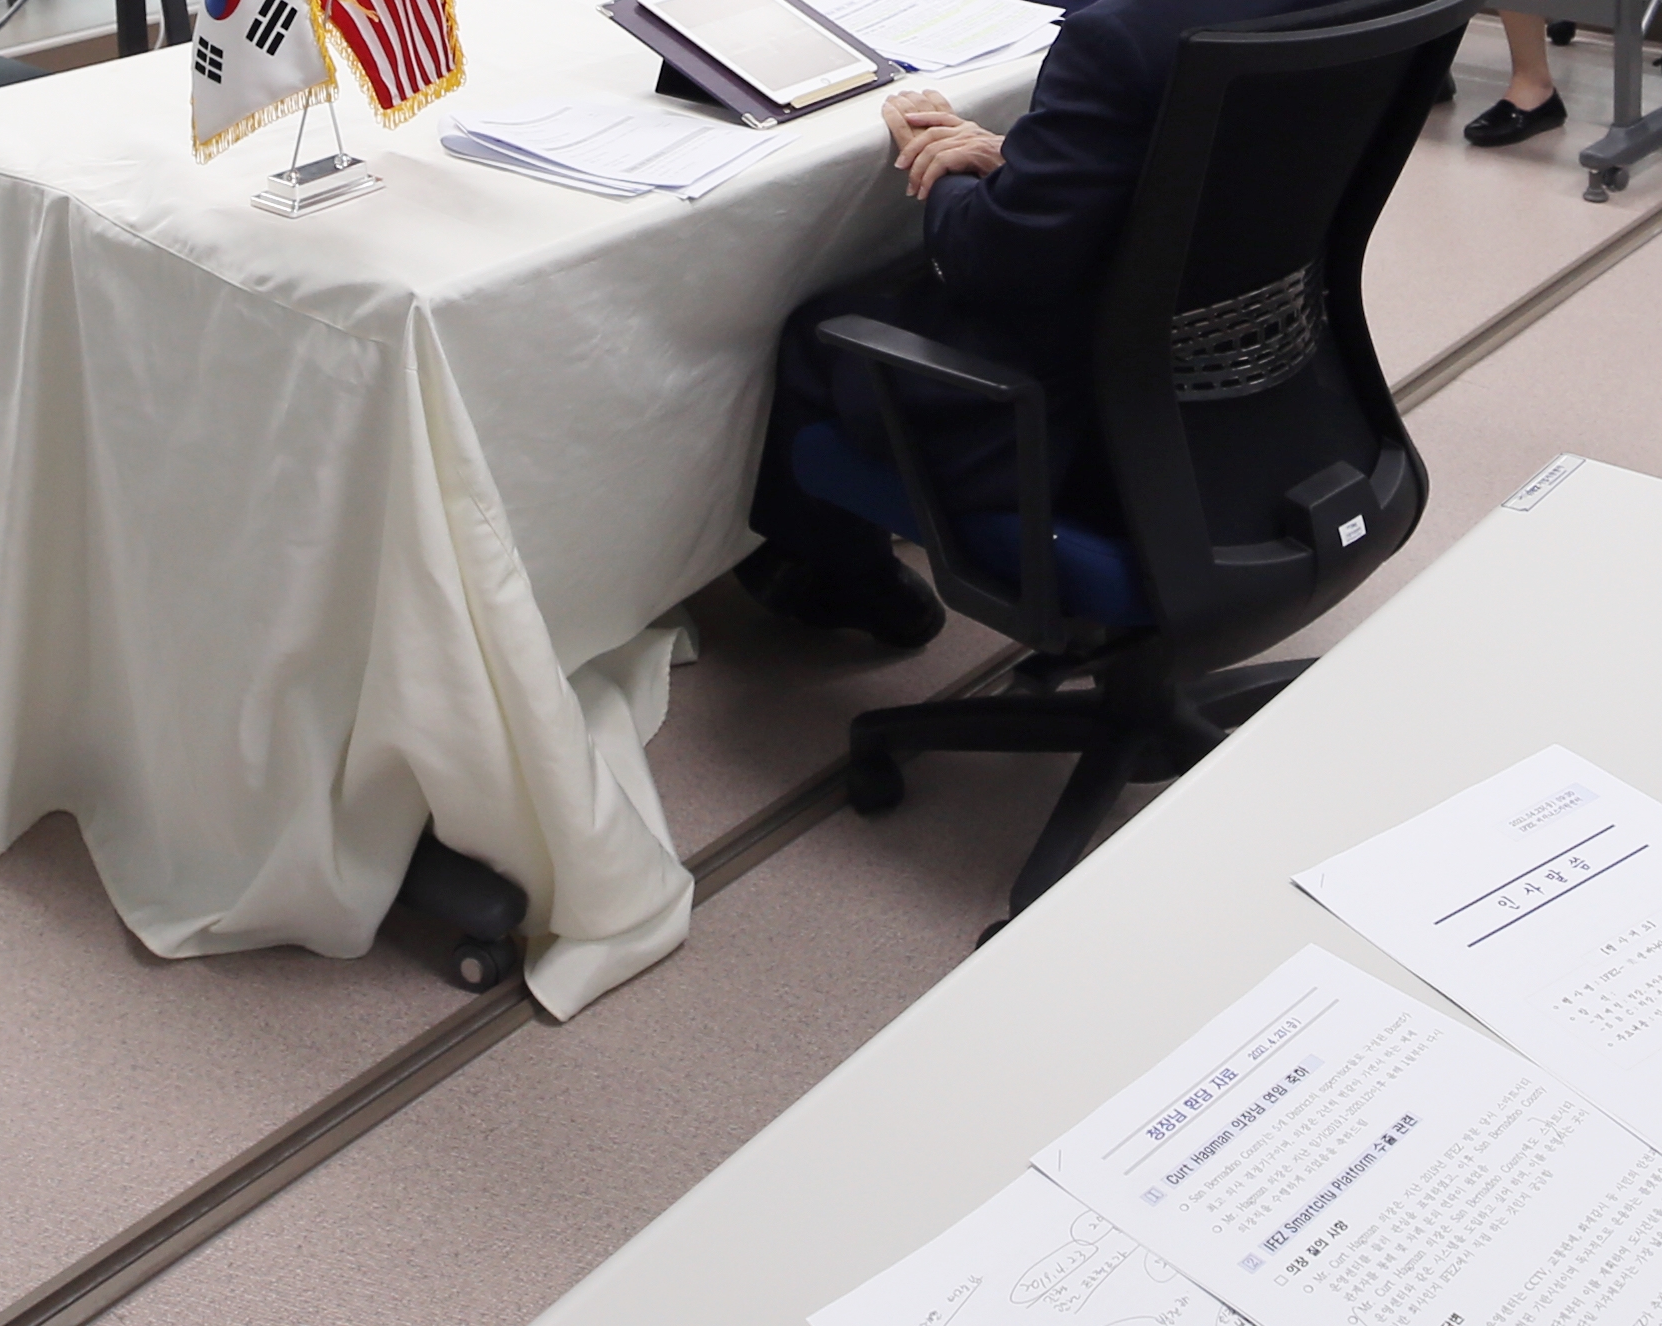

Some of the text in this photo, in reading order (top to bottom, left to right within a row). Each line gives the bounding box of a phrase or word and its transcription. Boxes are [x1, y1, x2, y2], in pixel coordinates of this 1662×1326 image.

[1145, 1107, 1188, 1140] 청장님
[1182, 1087, 1214, 1111] 환담
[1208, 1067, 1239, 1090] 자료
[1165, 1163, 1194, 1184] Curt
[1189, 1130, 1234, 1165] Hagman
[1231, 1102, 1266, 1131] 의장님
[1262, 1083, 1288, 1103] 연임
[1284, 1065, 1310, 1084] 축하
[1263, 1230, 1290, 1252] IFEZ
[1283, 1189, 1337, 1233] Smartcity
[1330, 1152, 1377, 1191] Platform
[1373, 1132, 1398, 1152] 수출
[1391, 1113, 1418, 1134] 관련
[1457, 1154, 1474, 1168] 이후
[1285, 1219, 1348, 1276] 의장 질의 사항
[1312, 1270, 1330, 1283] Mr.
[1328, 1252, 1350, 1268] Curt
[1378, 1200, 1404, 1222] 의장은
[1403, 1182, 1422, 1198] 지난
[1374, 1279, 1396, 1297] Curt
[1392, 1249, 1427, 1279] Hagman
[1425, 1224, 1452, 1247] 의장은
[1449, 1209, 1468, 1223] San
[1465, 1174, 1502, 1208] Bernadino
[1489, 1216, 1509, 1231] 하는
[1575, 1226, 1614, 1263] 독자적으로
[1634, 1246, 1654, 1264] 가장
[1374, 1282, 1416, 1322] 운영센터와
[1463, 1203, 1496, 1234] 도입하고
[1523, 1267, 1552, 1291] CCTV,
